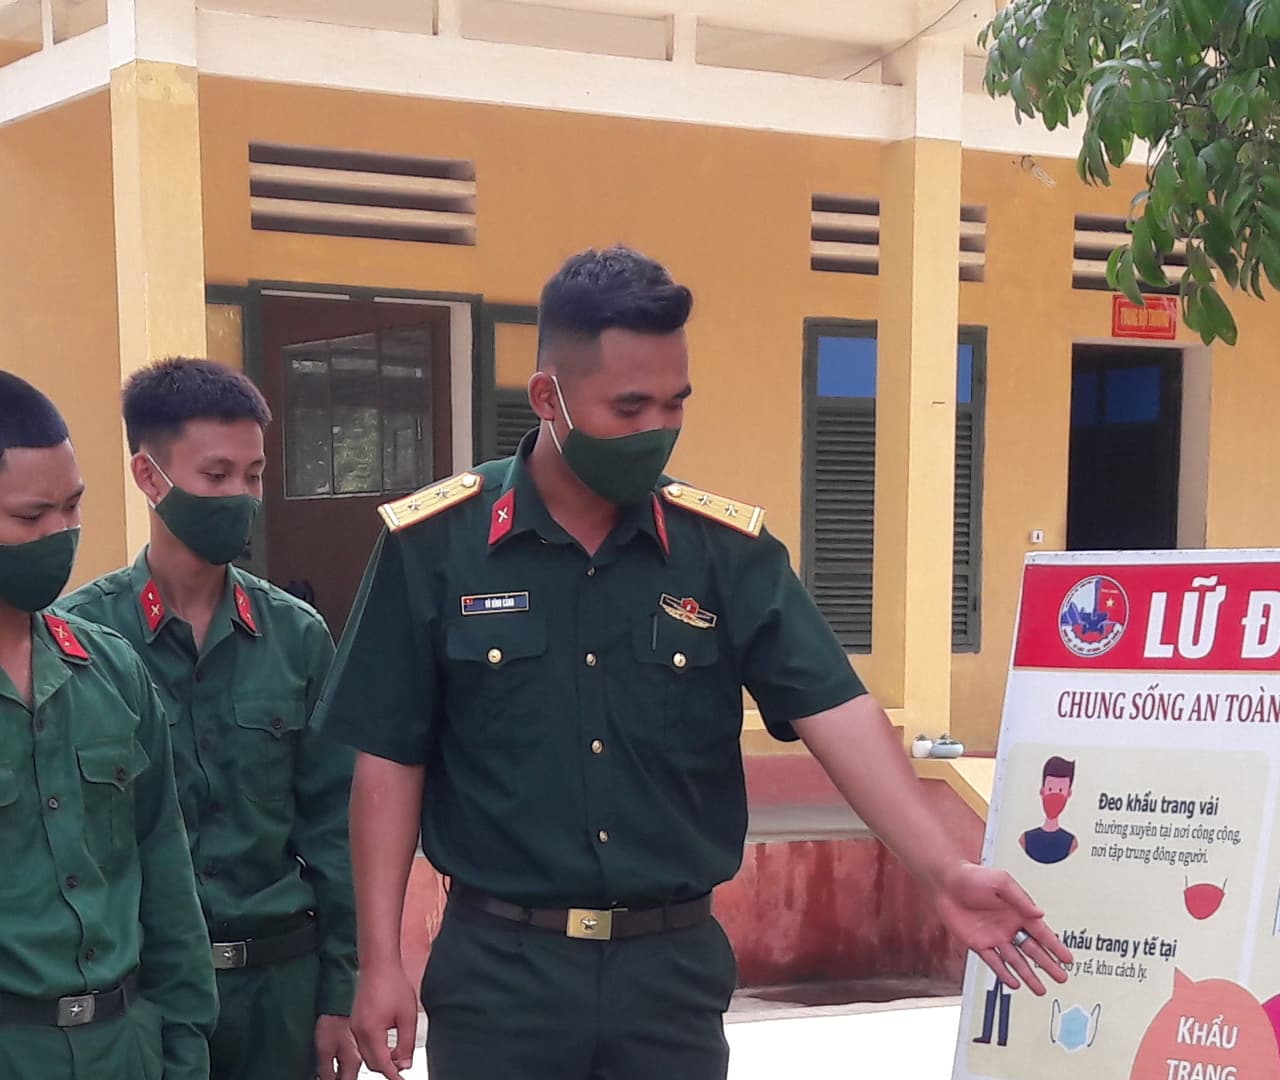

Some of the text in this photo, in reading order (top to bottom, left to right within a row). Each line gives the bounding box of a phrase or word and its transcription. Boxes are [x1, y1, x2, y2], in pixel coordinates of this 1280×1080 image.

[1143, 576, 1227, 658] LỮ
[1057, 689, 1126, 720] CHUNG
[1129, 683, 1184, 721] SỐNG
[1188, 693, 1219, 723] AN
[1098, 791, 1219, 818] Đeo khẩu trang vải
[1096, 934, 1129, 957] trang
[1133, 941, 1140, 958] y
[1143, 936, 1157, 955] tế
[1160, 940, 1177, 961] tại
[1176, 1014, 1238, 1049] KHẨU
